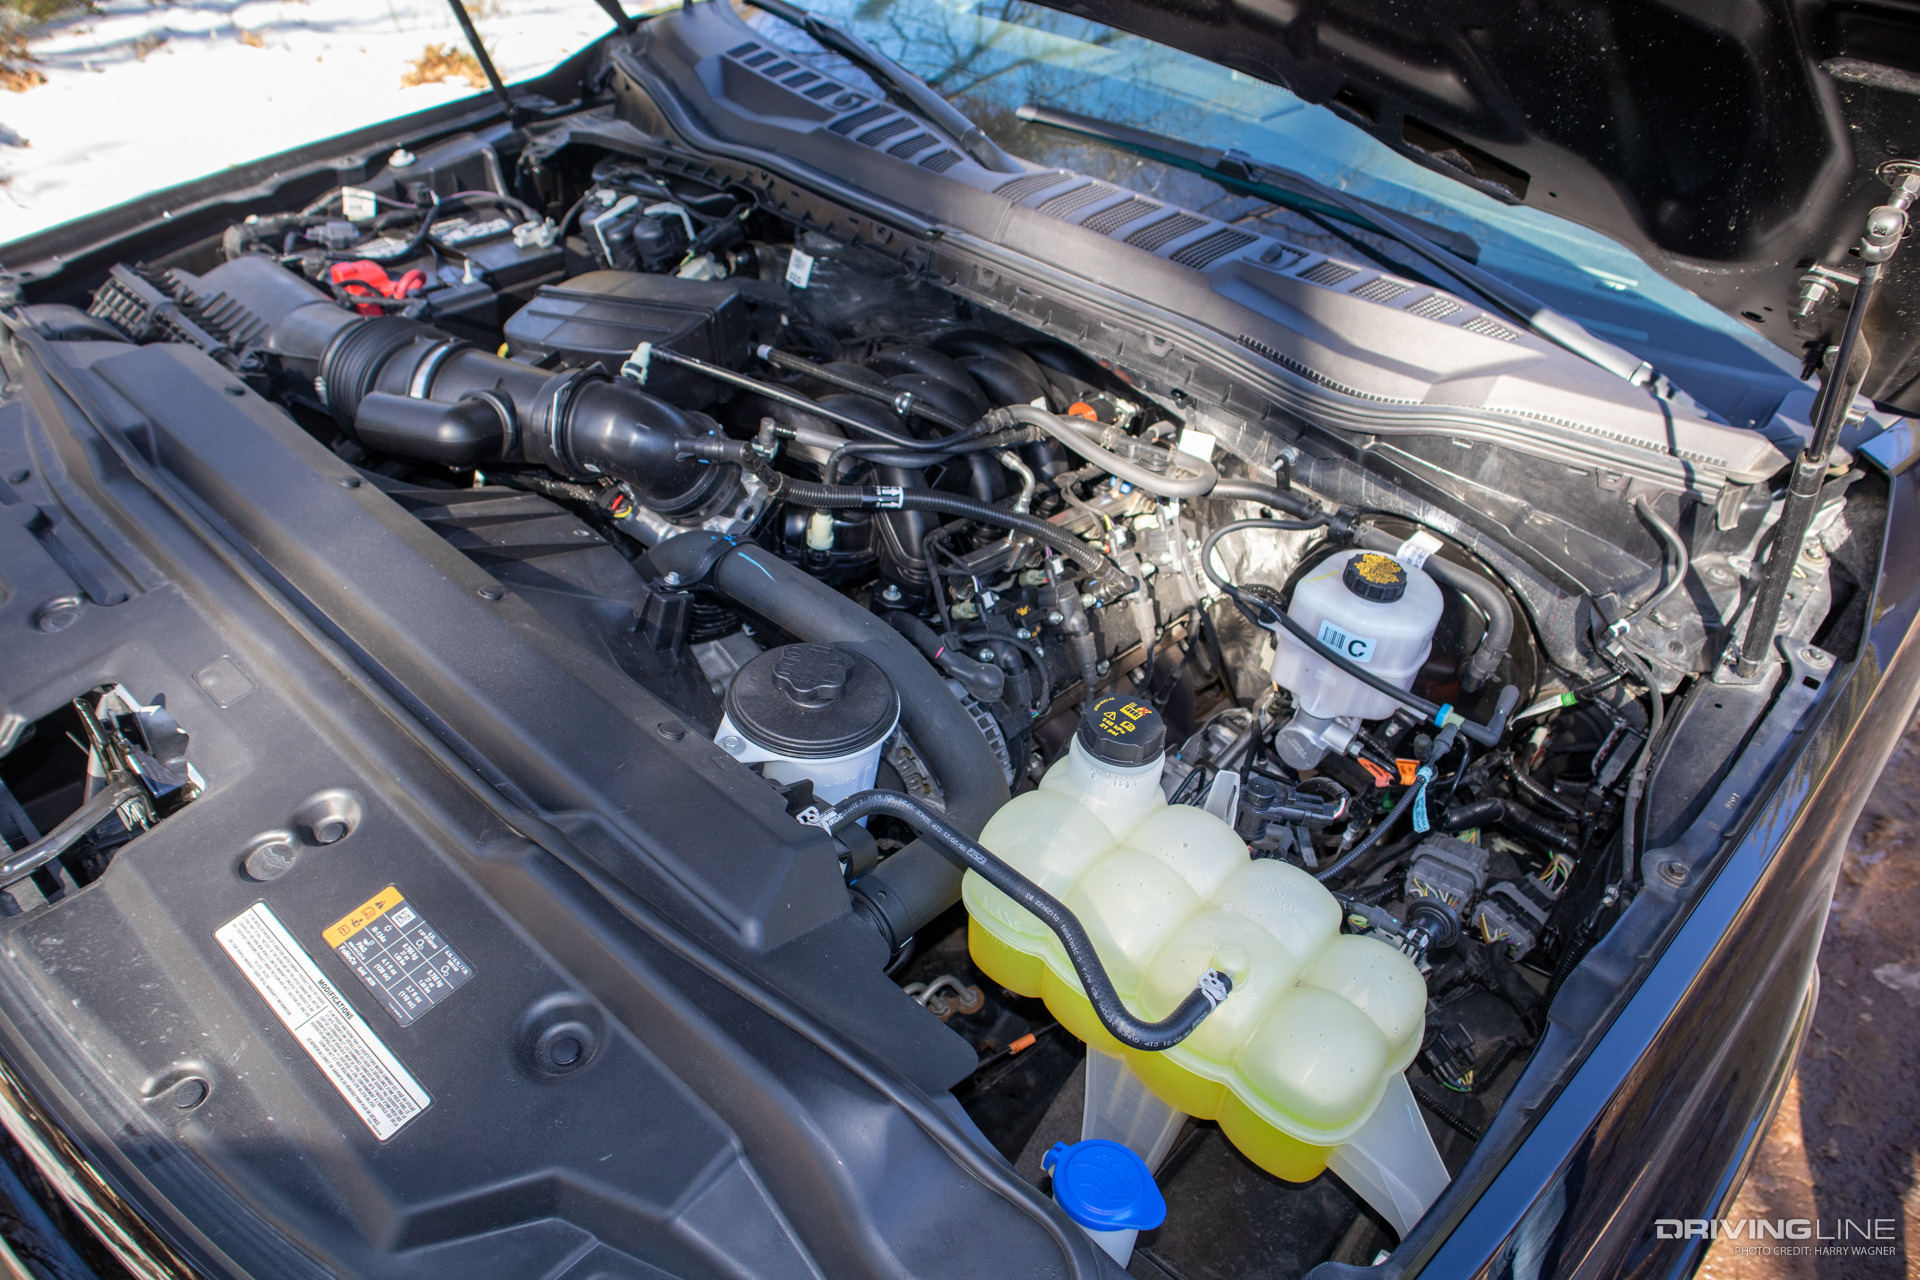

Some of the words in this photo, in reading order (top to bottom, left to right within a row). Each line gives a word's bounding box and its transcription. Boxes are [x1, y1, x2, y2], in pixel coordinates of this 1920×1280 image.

[1348, 640, 1368, 658] C
[355, 941, 368, 953] PAG
[338, 945, 357, 966] FoMoCo
[355, 965, 367, 977] SAE
[316, 978, 353, 1019] MODIFICATIONS
